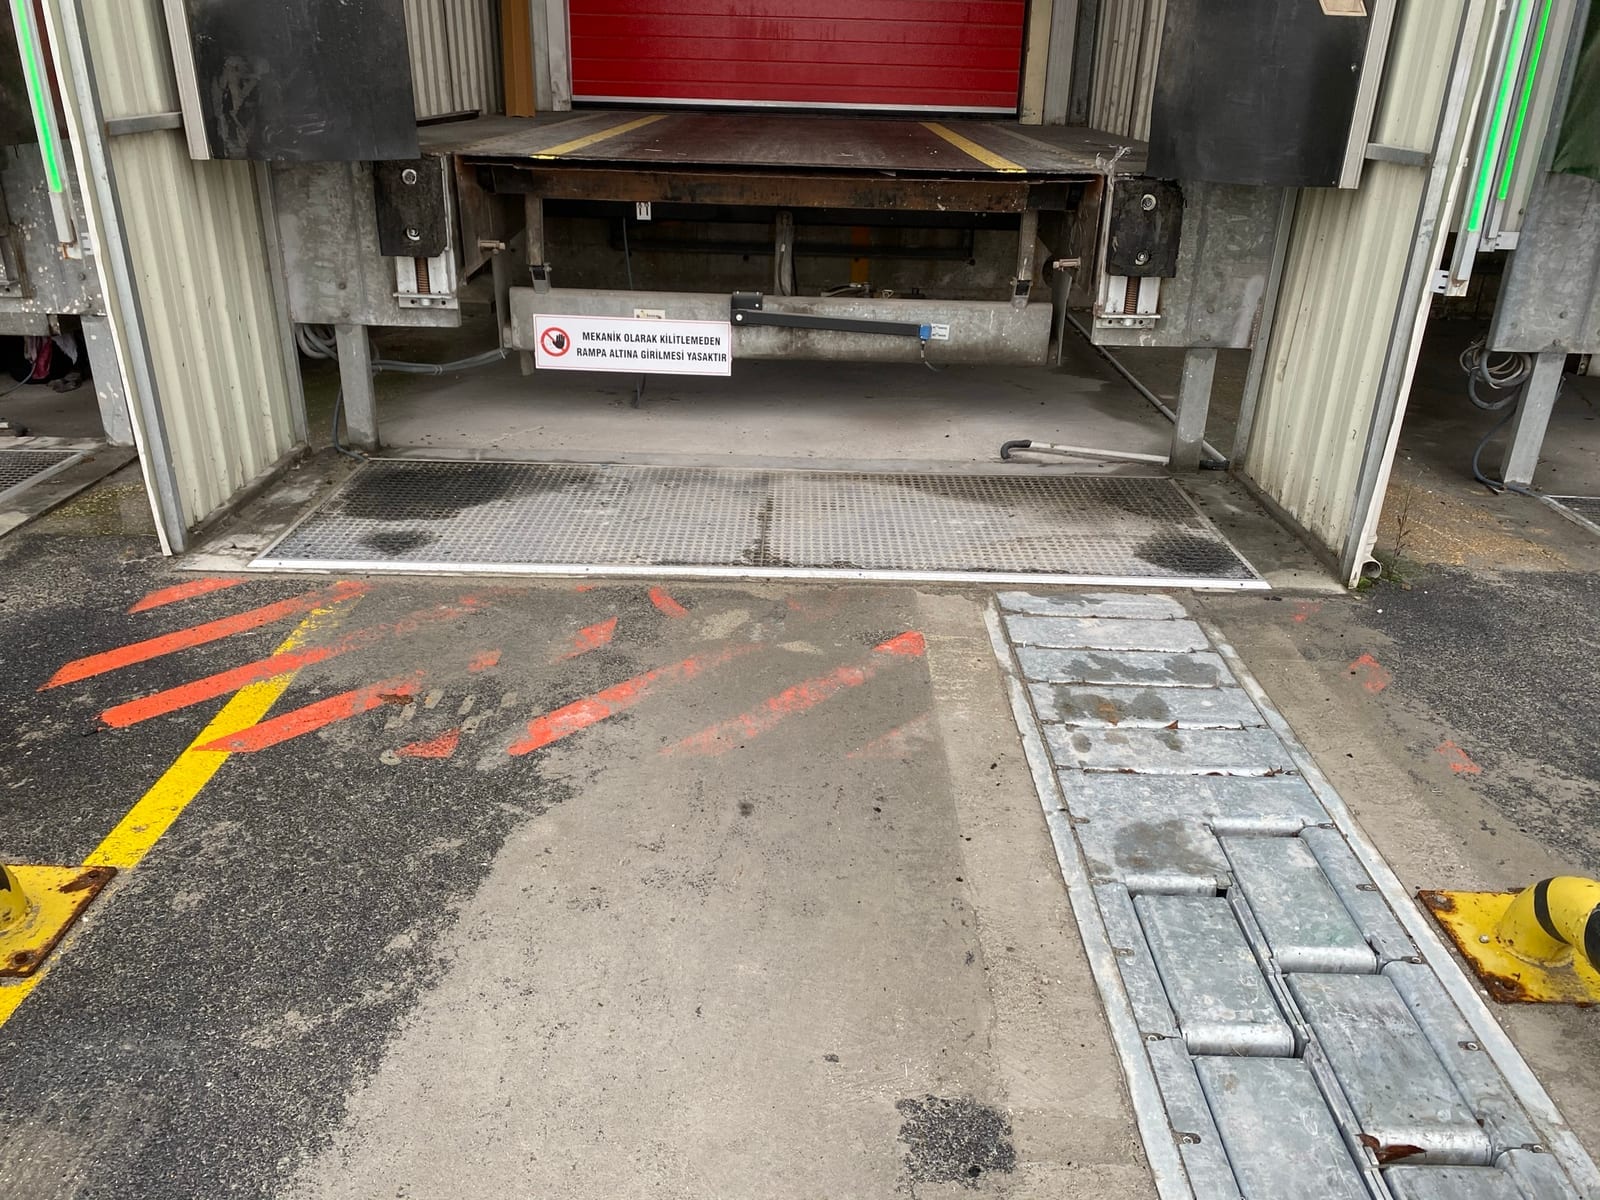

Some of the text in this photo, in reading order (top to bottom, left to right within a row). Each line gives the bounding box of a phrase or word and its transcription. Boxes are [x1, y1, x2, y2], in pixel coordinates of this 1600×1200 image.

[582, 331, 721, 346] MEKANİK OLARAK KİLİTLEMEDEN
[576, 347, 728, 362] RAMPA ALTINA GİRİLMESİ YASAKTIR
